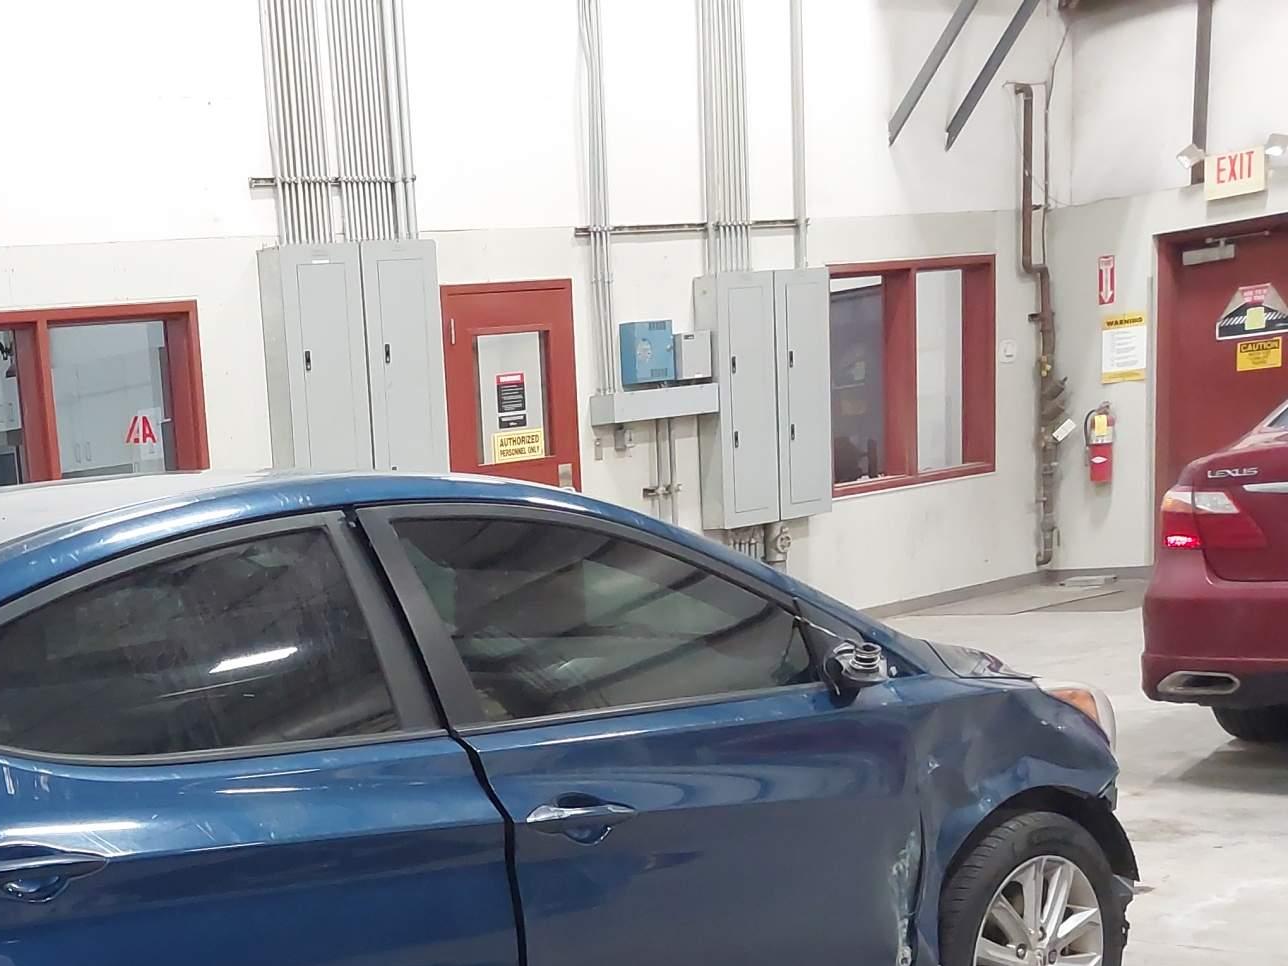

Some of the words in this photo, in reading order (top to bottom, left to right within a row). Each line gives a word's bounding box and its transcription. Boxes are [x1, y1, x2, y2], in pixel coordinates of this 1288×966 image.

[1216, 150, 1255, 185] EXIT
[1106, 317, 1143, 326] WARNING
[1240, 341, 1279, 352] CAUTION
[500, 434, 540, 447] AUTHORIZED
[500, 448, 527, 457] PERSONNEL
[527, 445, 540, 454] ONLY
[1207, 467, 1259, 478] LEXUS
